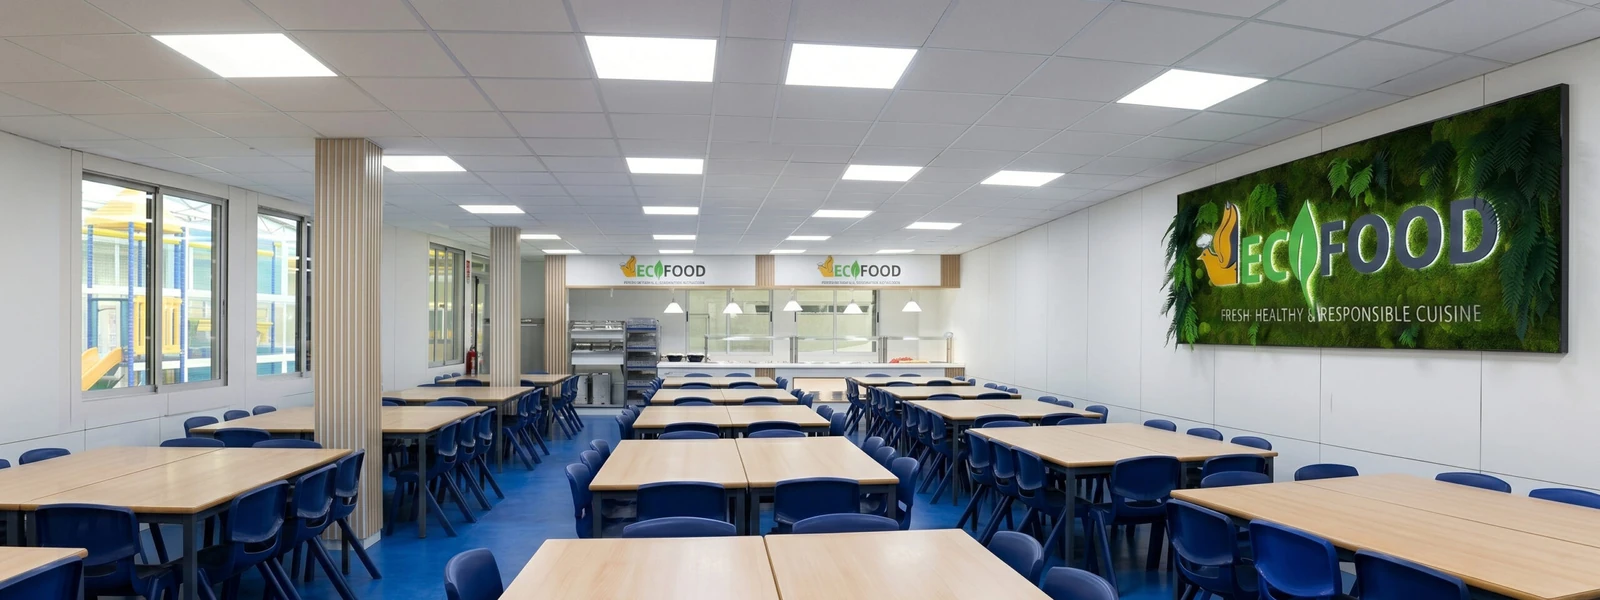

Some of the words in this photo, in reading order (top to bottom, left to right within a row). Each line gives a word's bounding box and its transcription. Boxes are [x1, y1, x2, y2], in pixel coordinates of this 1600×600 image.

[1255, 307, 1304, 322] HEALTHY
[1319, 306, 1411, 322] RESPONSIBLE
[1416, 305, 1481, 322] CUISINE
